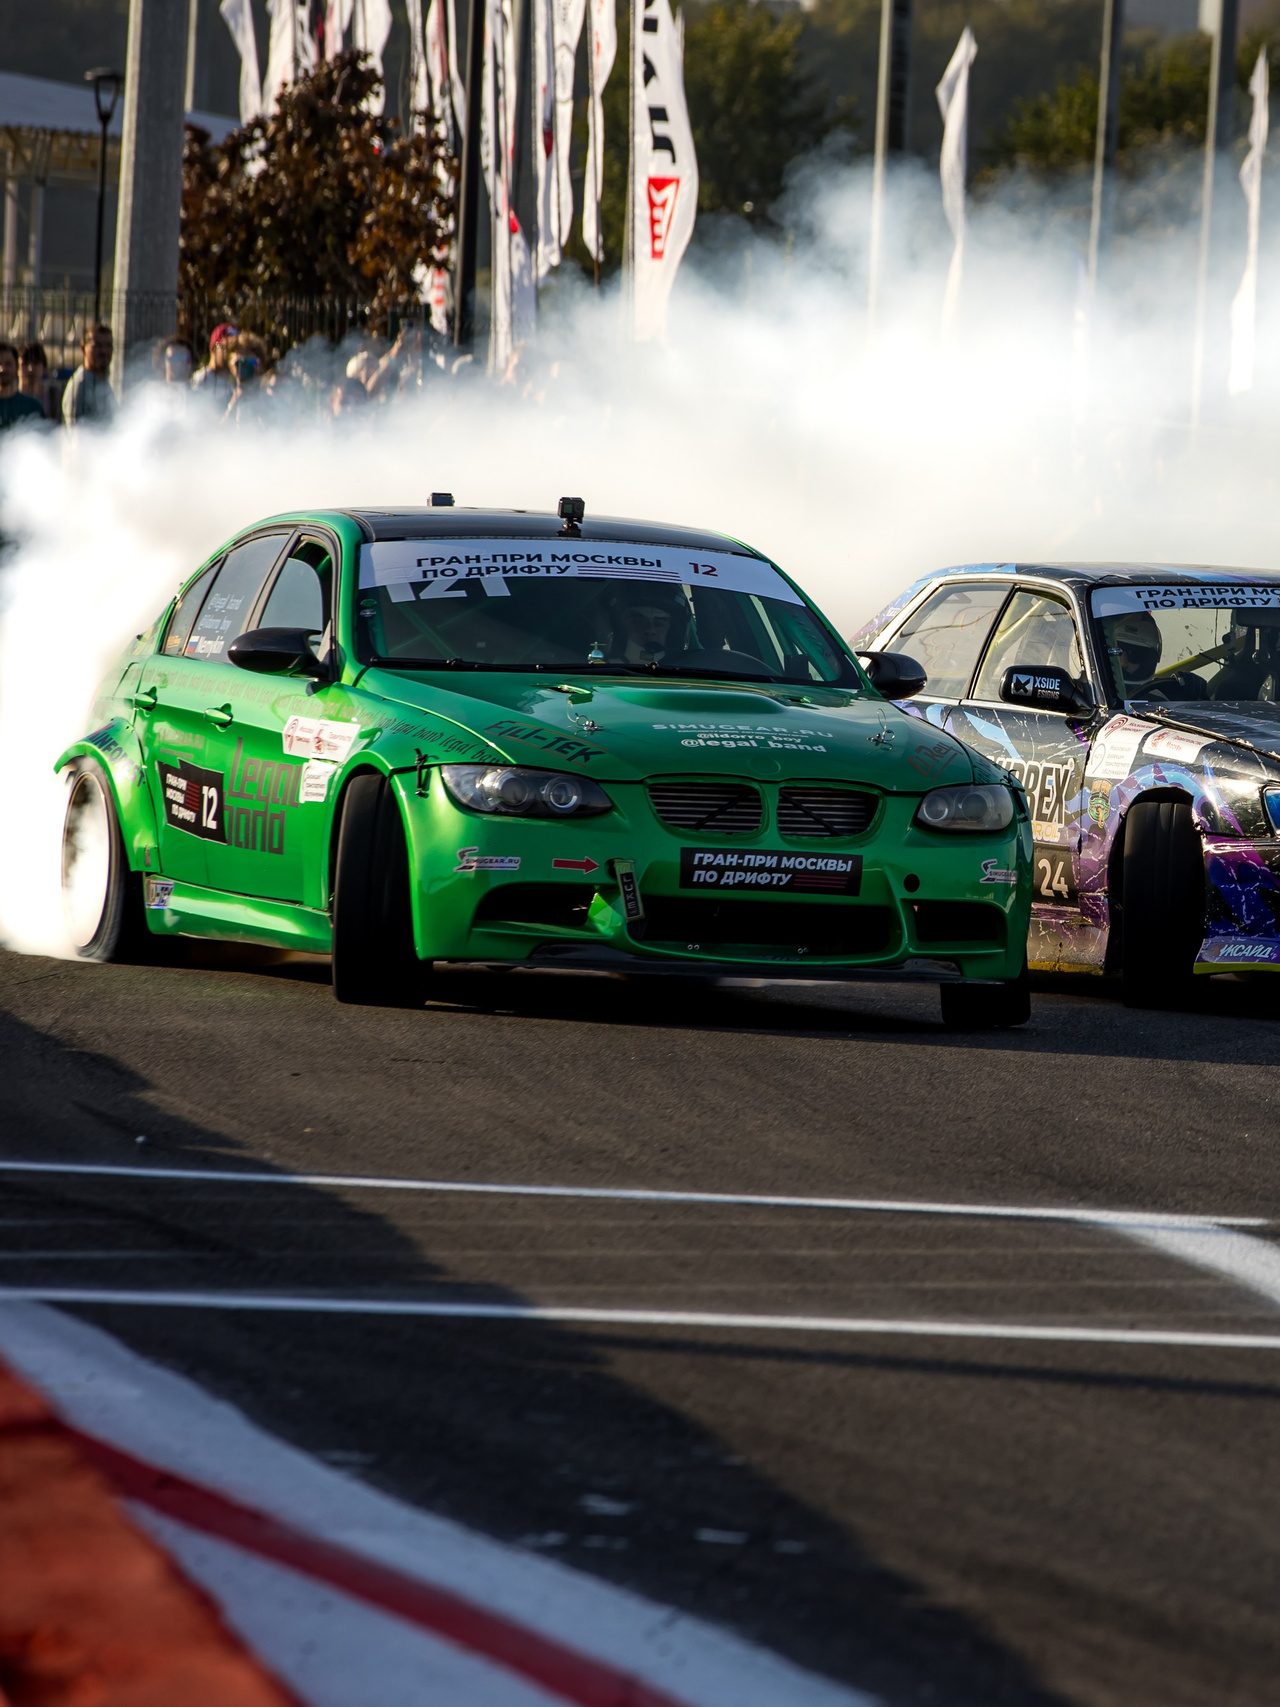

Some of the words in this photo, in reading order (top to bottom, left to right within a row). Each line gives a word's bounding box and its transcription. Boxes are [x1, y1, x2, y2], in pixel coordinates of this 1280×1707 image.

[416, 553, 543, 568] ГРАН-ПРИ
[551, 553, 662, 568] МОСКВЫ
[422, 566, 458, 579] ПО
[465, 565, 571, 578] ДРИФТУ
[688, 562, 718, 577] 12
[1135, 587, 1247, 599] ГРАН-ПРИ
[1144, 599, 1180, 609] ПО
[1182, 597, 1272, 609] ДРИФТУ
[652, 723, 834, 738] SIMUGEAR.RU
[439, 734, 477, 756] legal
[681, 738, 827, 752] @legal_band
[202, 785, 218, 829] 12
[465, 857, 520, 865] SIMUGEAR.RU
[693, 853, 778, 868] ГРАН-ПРИ
[780, 856, 853, 872] МОСКВЫ
[692, 870, 718, 883] ПО
[720, 871, 792, 886] ДРИФТУ
[1038, 858, 1069, 899] 24
